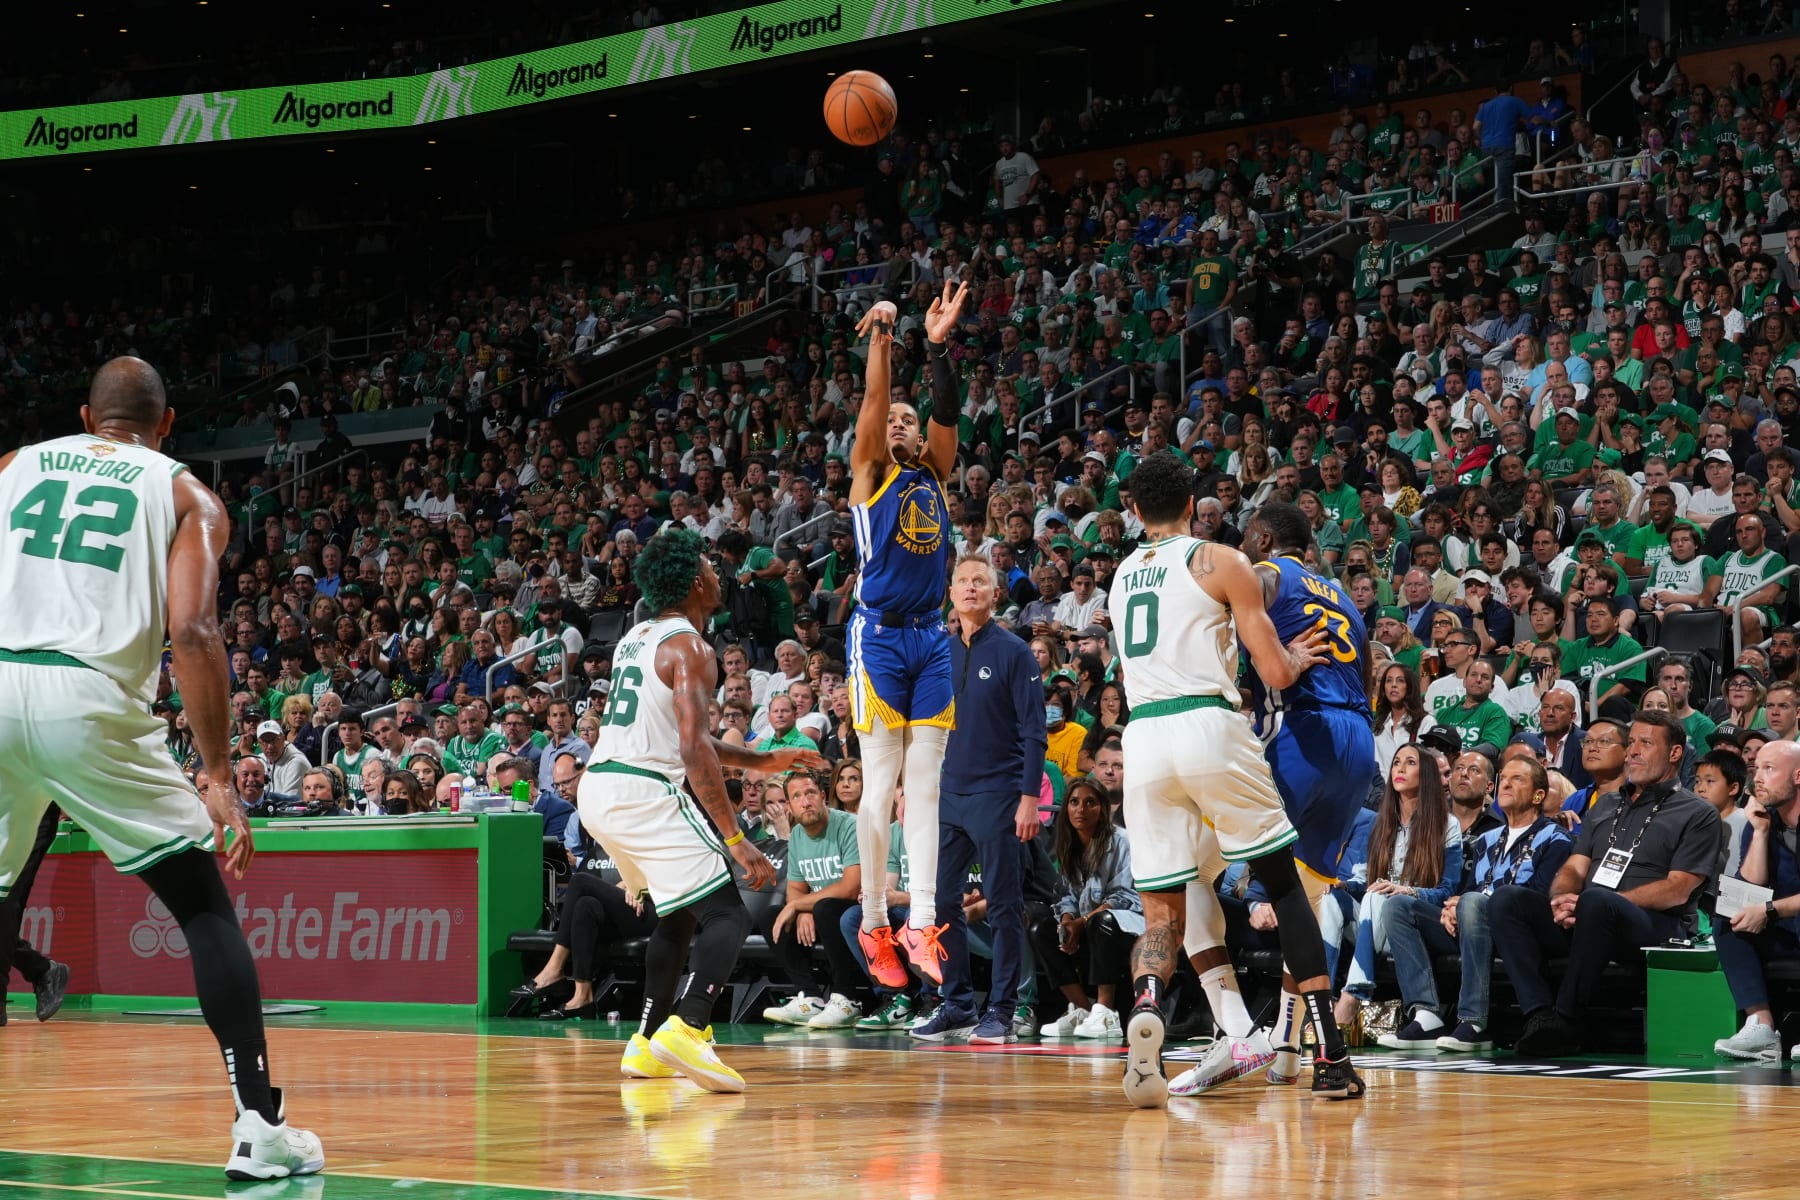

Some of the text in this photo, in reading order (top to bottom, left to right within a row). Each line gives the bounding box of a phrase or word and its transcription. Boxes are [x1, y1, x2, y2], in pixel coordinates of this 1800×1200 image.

[729, 5, 842, 53] Algorand
[507, 54, 608, 98] Algorand
[273, 91, 393, 128] Algorand
[24, 115, 138, 150] Algorand
[1434, 204, 1456, 223] EXIT
[1199, 274, 1211, 290] 0
[40, 451, 144, 484] HORFORD
[928, 499, 936, 516] 3
[10, 478, 139, 573] 42
[1122, 566, 1168, 592] TATUM
[1301, 575, 1340, 605] GREEN
[1658, 570, 1691, 584] CELTICS
[1124, 590, 1160, 660] 0
[1303, 602, 1358, 663] 23
[798, 856, 844, 882] CELTICS
[234, 891, 323, 960] tate
